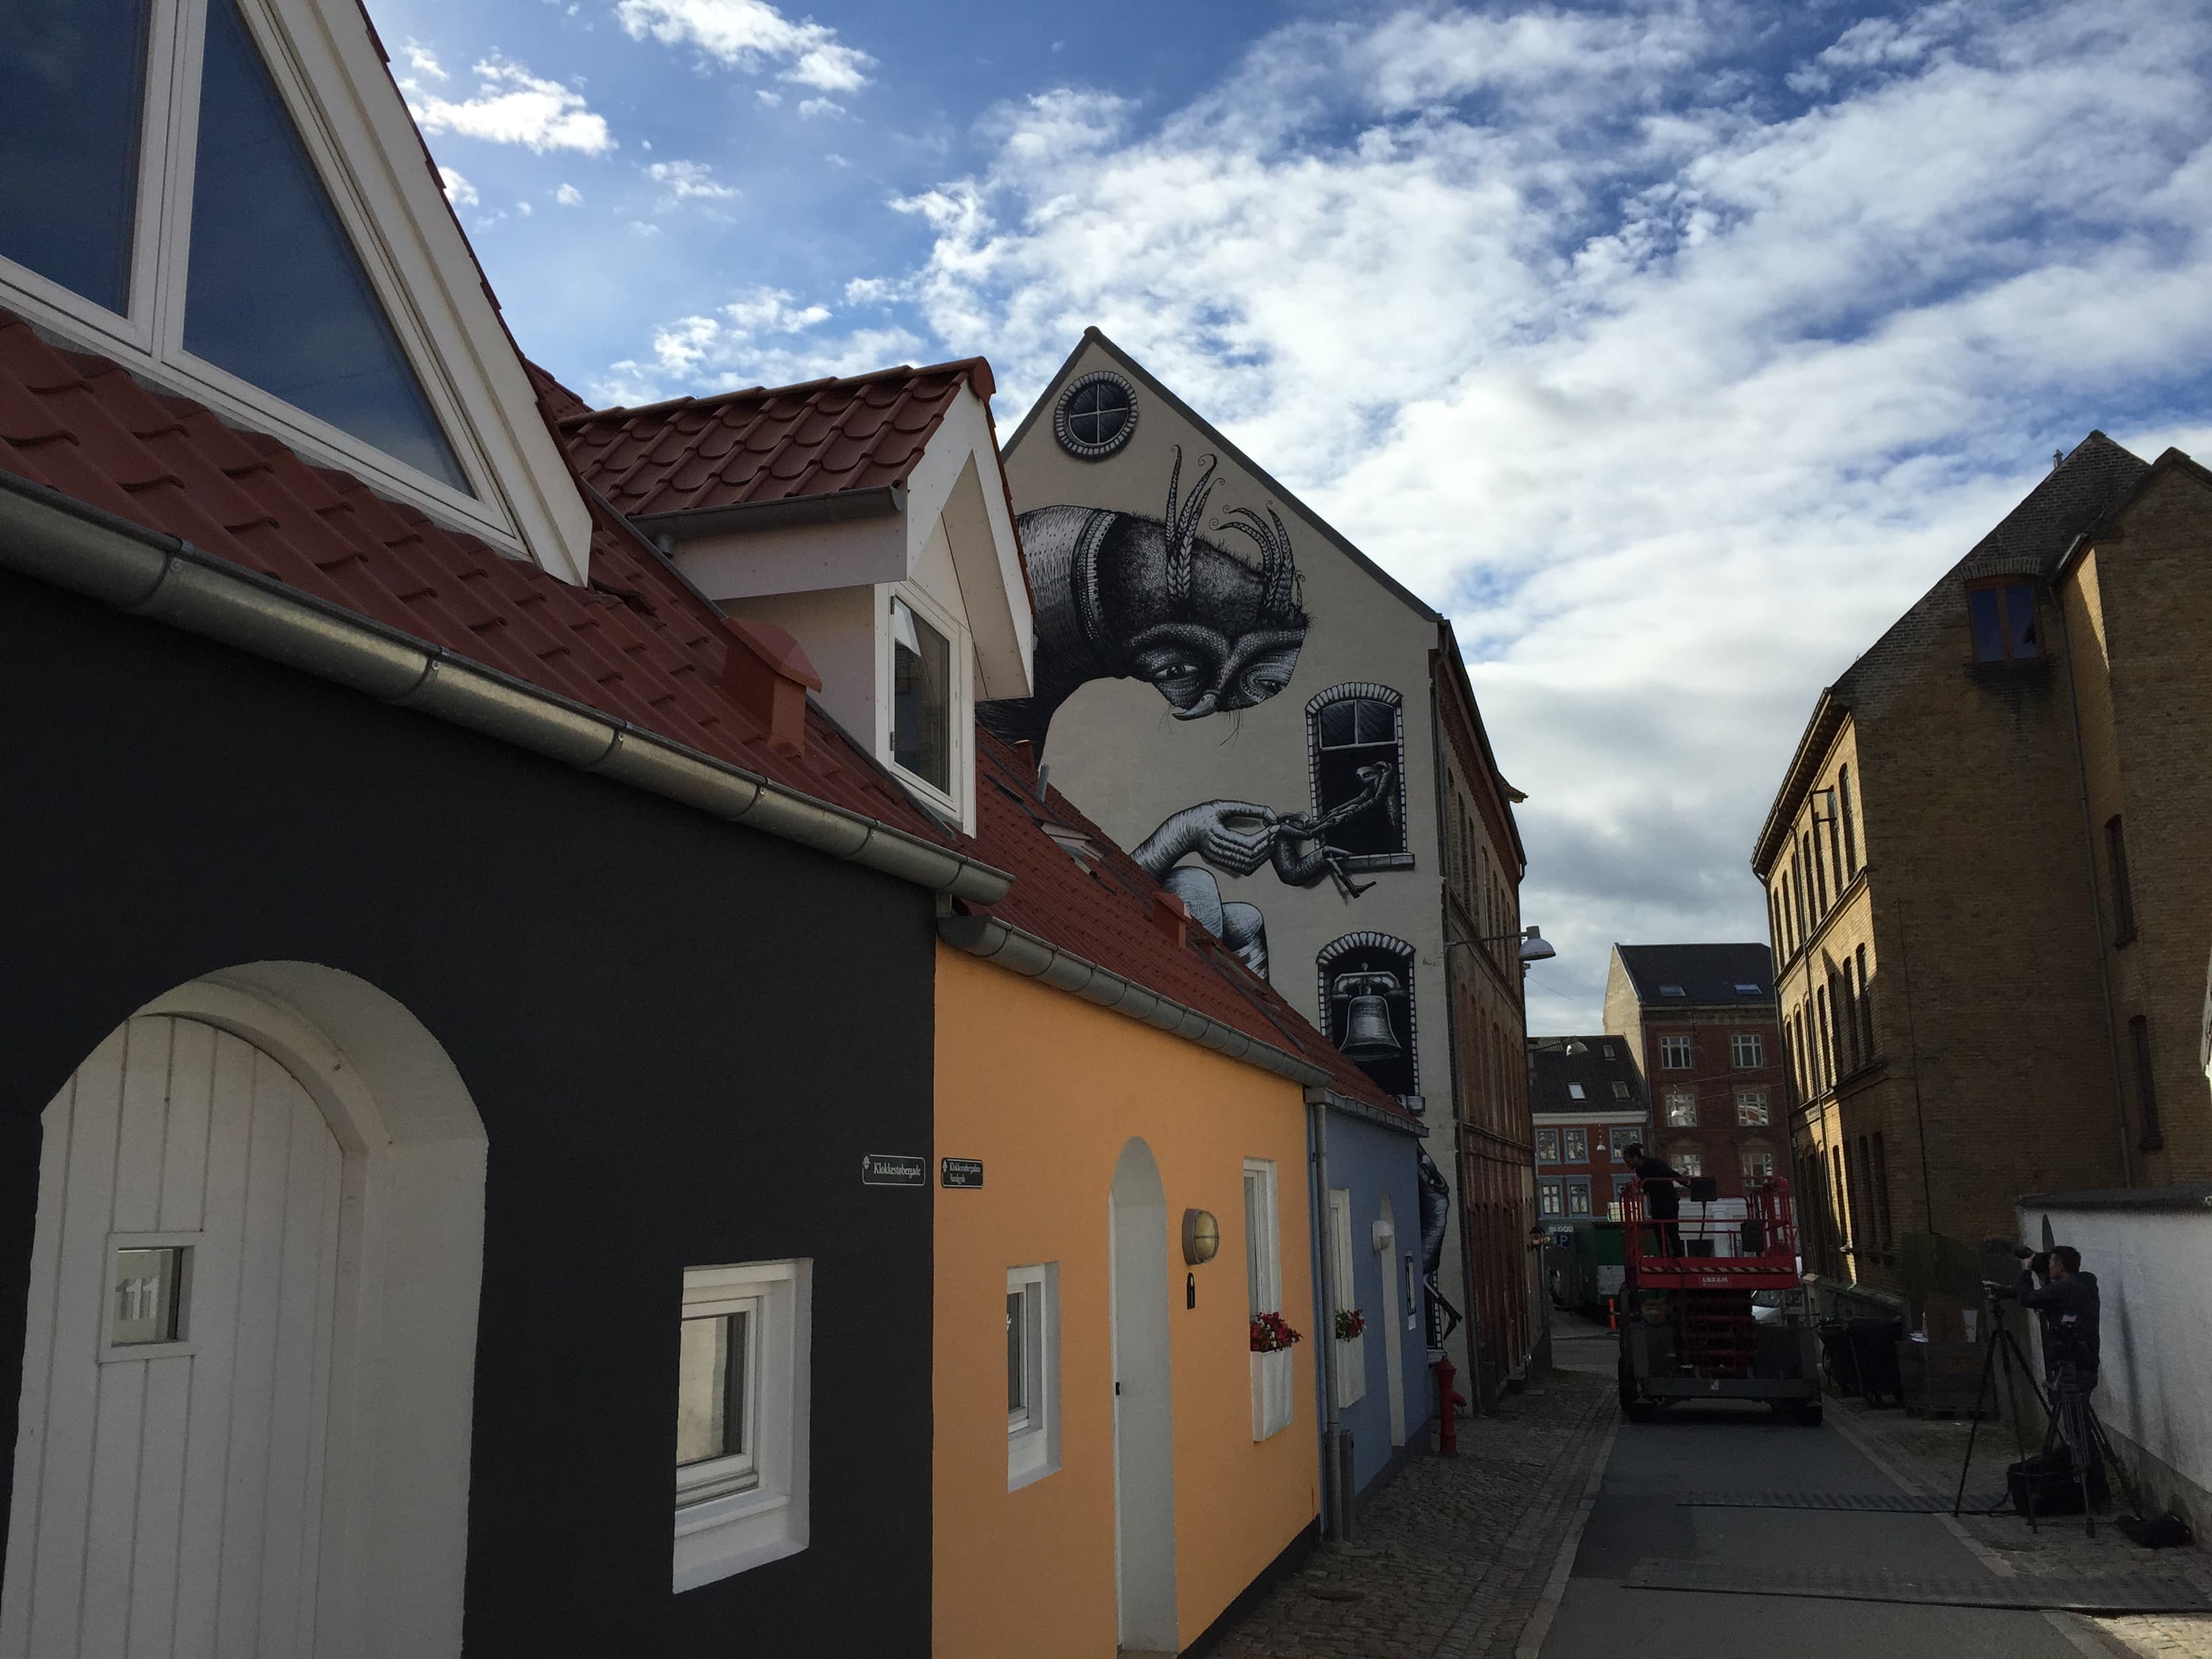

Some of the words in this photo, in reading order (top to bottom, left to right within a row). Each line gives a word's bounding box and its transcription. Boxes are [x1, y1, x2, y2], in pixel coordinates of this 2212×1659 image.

[874, 1162, 921, 1179] Klokkestøbergade
[1560, 1235, 1569, 1247] P
[125, 1277, 159, 1320] 11
